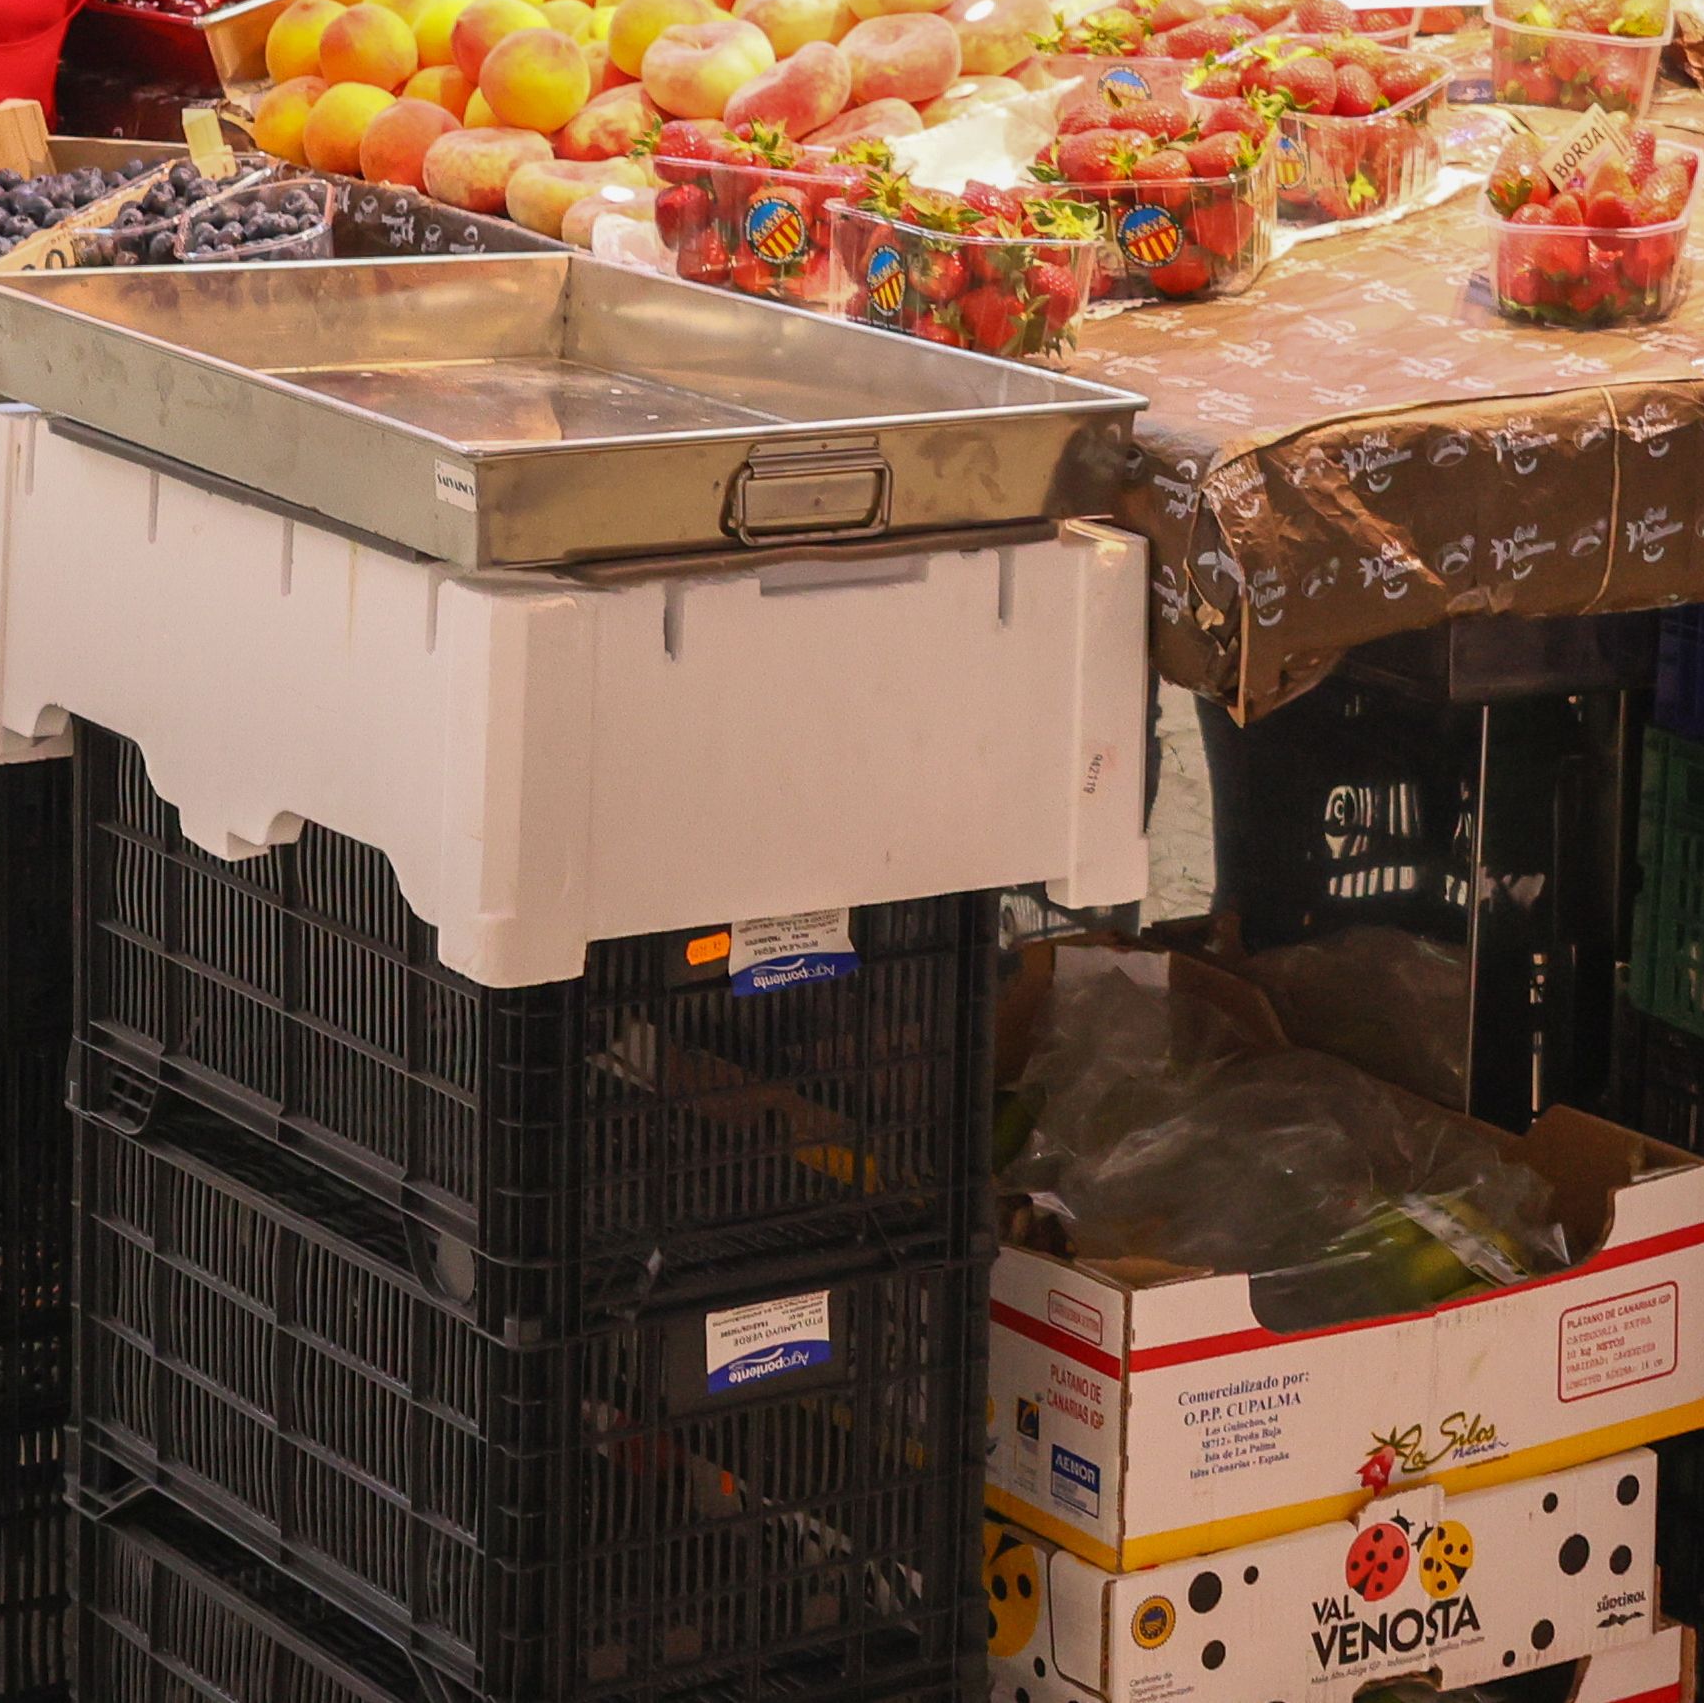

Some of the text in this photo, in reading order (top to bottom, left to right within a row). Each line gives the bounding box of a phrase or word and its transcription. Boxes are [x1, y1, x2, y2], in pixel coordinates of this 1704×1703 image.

[1552, 126, 1604, 180] BORJA
[753, 963, 835, 990] Agroponiente
[728, 1351, 810, 1384] Agroponiente
[1177, 1371, 1311, 1407] Comercializado por:
[1184, 1392, 1302, 1427] O.P.P. CUPALMA
[1439, 1411, 1496, 1449] Silos
[1205, 1441, 1276, 1464] Isla de La Palma
[1055, 1453, 1099, 1487] AENOR
[1311, 1594, 1356, 1626] VAL
[1311, 1593, 1481, 1671] VENOSTA
